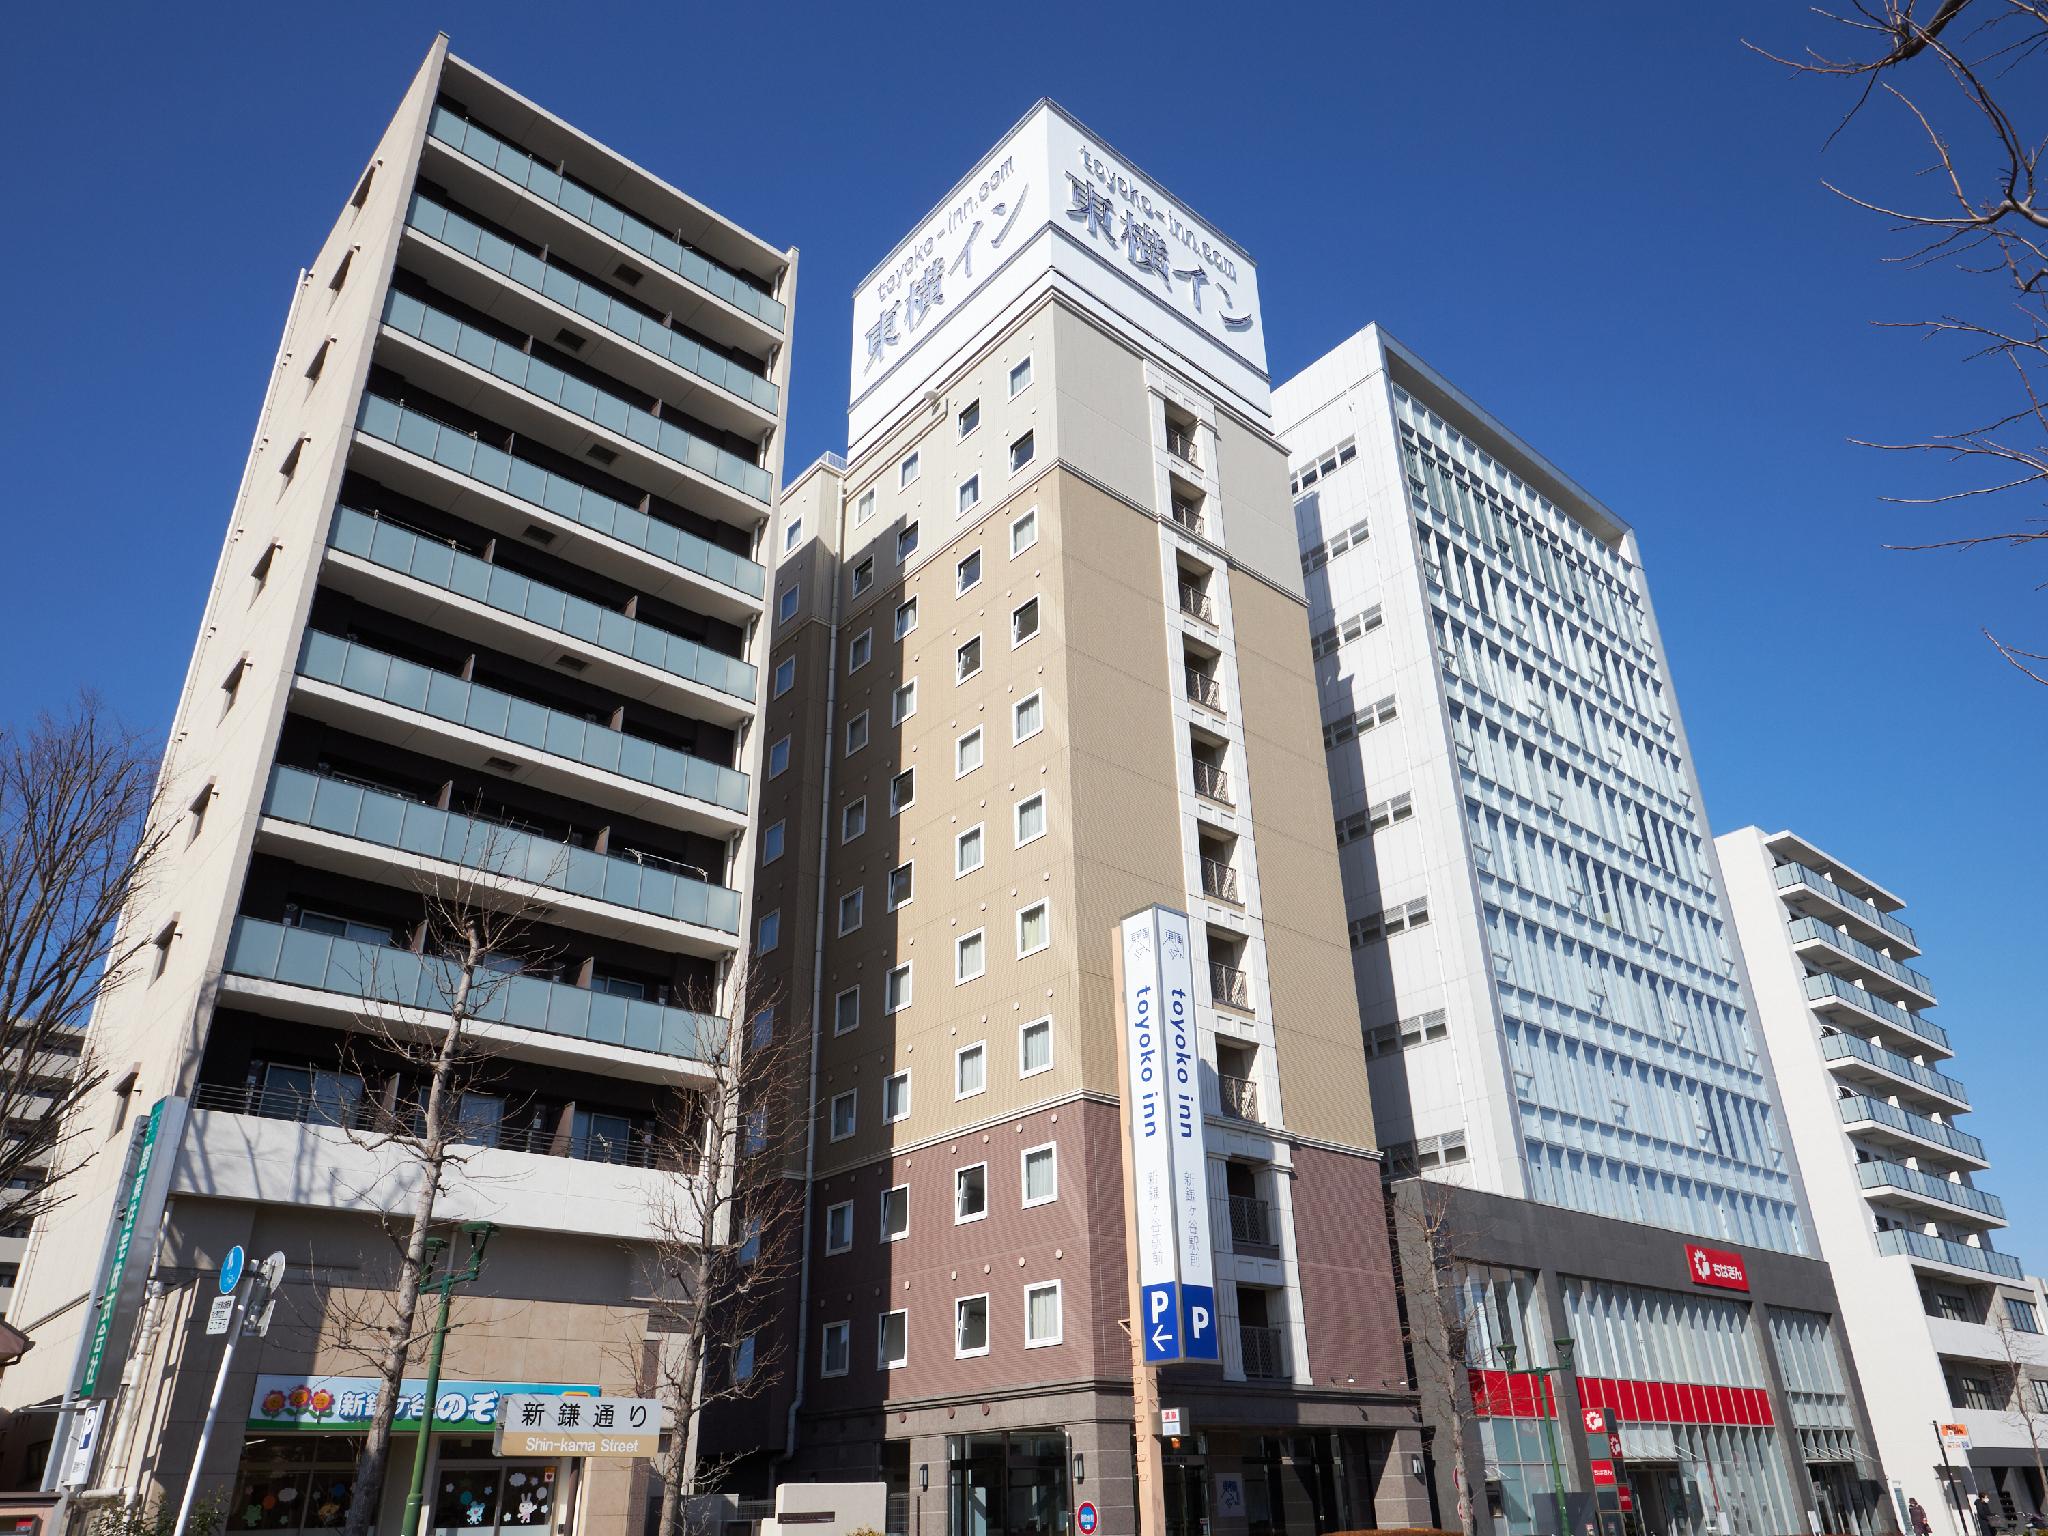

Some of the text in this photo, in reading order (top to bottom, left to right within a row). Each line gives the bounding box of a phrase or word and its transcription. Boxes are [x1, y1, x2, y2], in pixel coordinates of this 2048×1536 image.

[863, 182, 1029, 376] 東横イン
[878, 156, 1015, 302] toyoko-inn.com
[1064, 170, 1253, 331] 東横イン
[1078, 145, 1238, 284] toyoko-inn.com
[1134, 984, 1158, 1138] toyoko inn
[1170, 987, 1194, 1138] toyoko inn
[1151, 1290, 1169, 1324] P
[1192, 1306, 1209, 1339] P
[521, 1402, 647, 1428] 新鎌通り
[525, 1437, 639, 1453] Shin-kama Street
